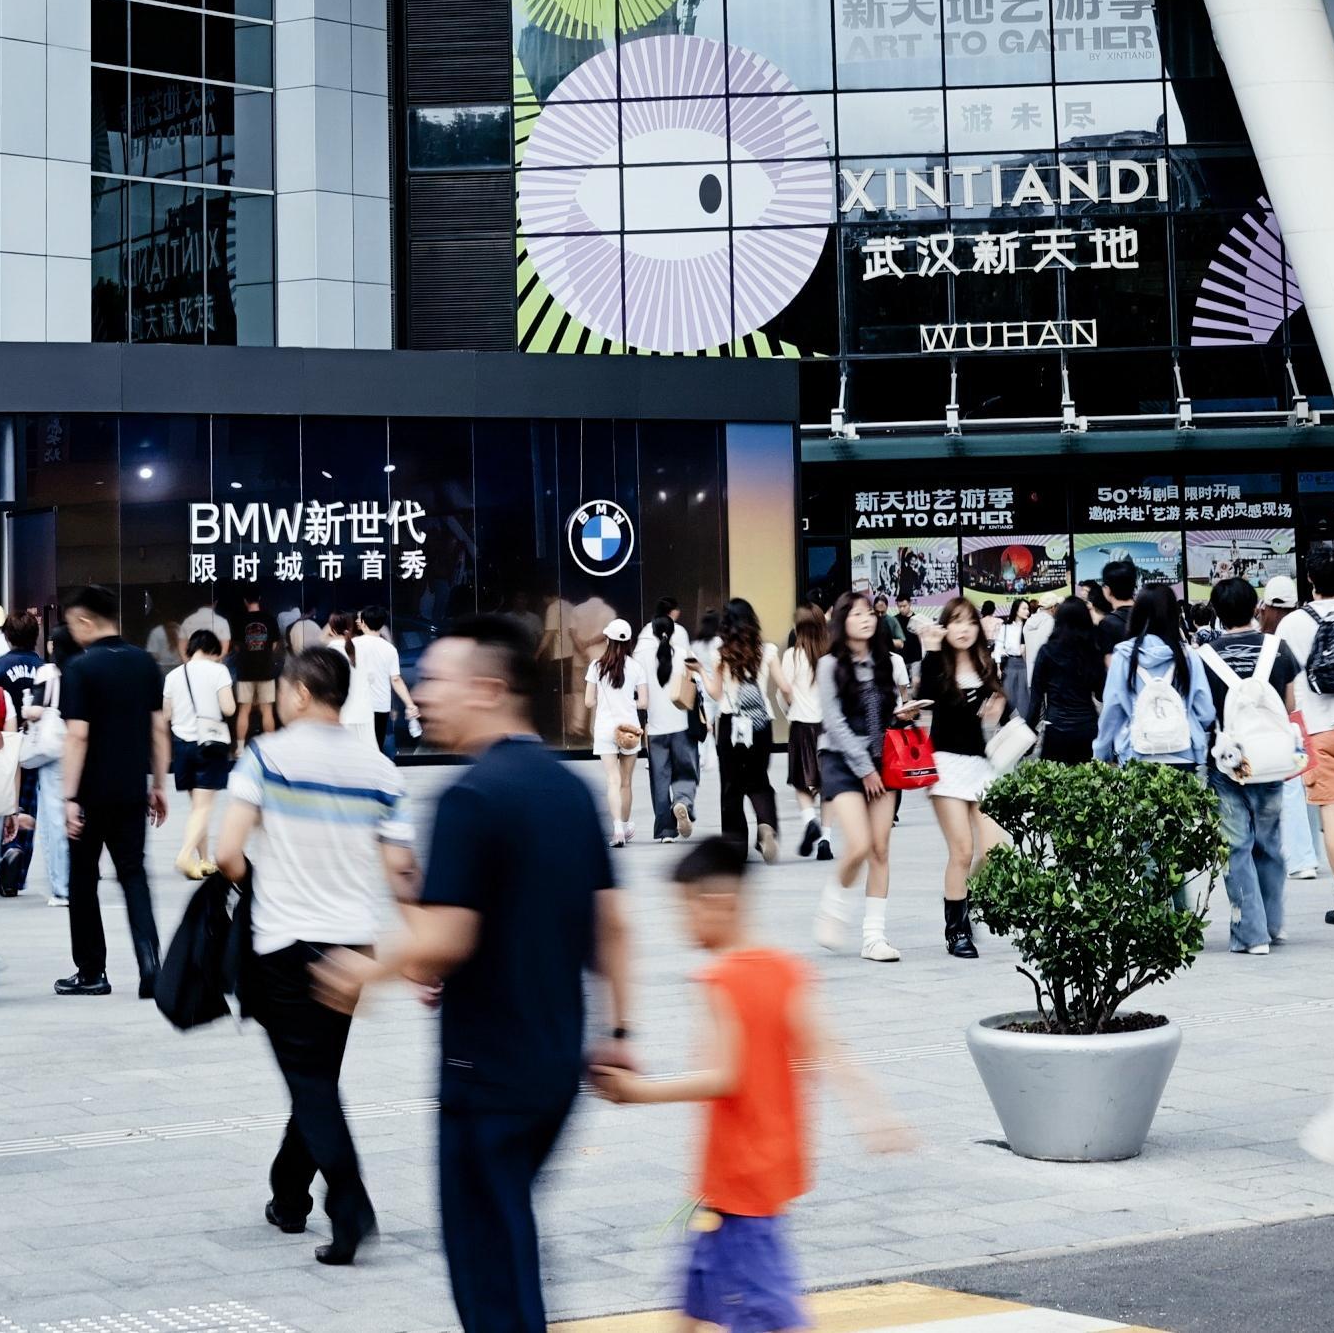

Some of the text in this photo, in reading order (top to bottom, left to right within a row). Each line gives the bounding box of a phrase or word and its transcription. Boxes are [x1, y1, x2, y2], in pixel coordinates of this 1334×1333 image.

[845, 25, 1155, 60] ART TO GATHER
[1089, 50, 1156, 61] BY XINTIANDI
[908, 100, 1097, 134] 艺游未尽
[840, 158, 1169, 214] XINTIANDI
[861, 225, 1140, 282] 武汉新天地
[919, 319, 1098, 352] WUHAN
[855, 486, 1014, 512] 新天地艺游季
[1184, 484, 1241, 501] 限时开展
[189, 500, 427, 546] BMW新世代
[856, 511, 1014, 529] ART TO GATHER
[190, 551, 428, 584] 限时城市首秀
[7, 665, 36, 682] ENGLA
